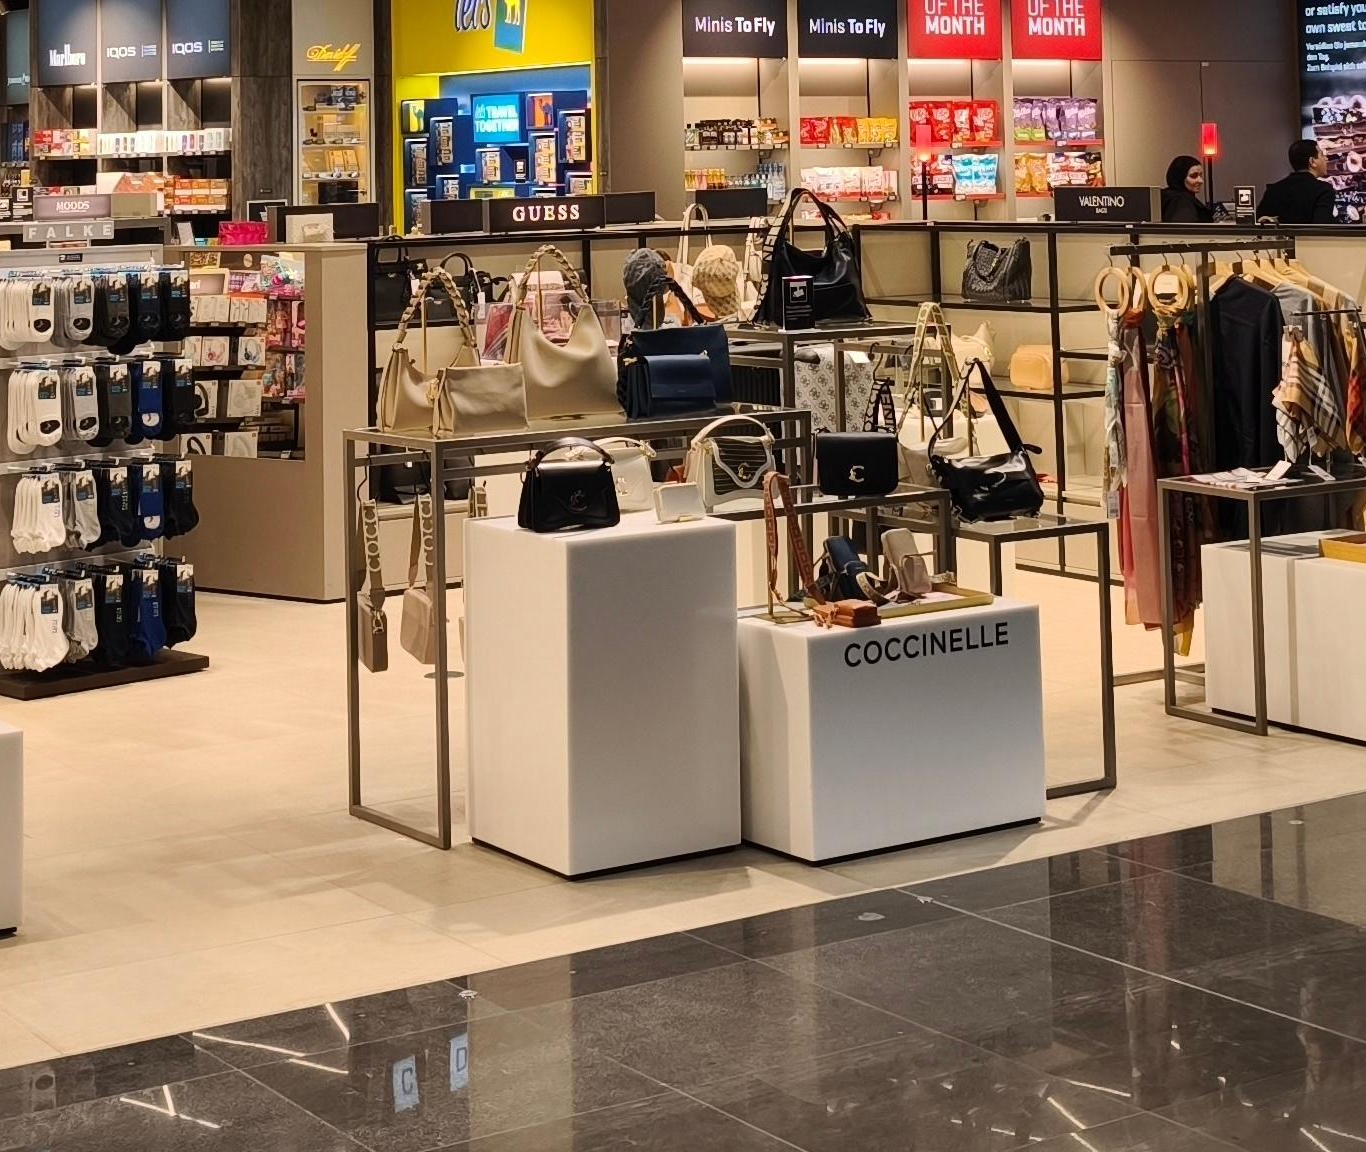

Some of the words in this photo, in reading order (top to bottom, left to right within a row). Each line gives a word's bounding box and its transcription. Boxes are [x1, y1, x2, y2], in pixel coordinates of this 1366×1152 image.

[1305, 6, 1316, 17] or
[1316, 2, 1349, 17] satisfy
[695, 16, 733, 33] Minis
[735, 16, 752, 33] To
[754, 16, 776, 37] Fly
[809, 18, 846, 34] Minis
[847, 18, 864, 34] To
[865, 18, 886, 38] Fly
[925, 15, 985, 35] MONTH
[1028, 17, 1085, 36] MONTH
[1305, 24, 1326, 34] own
[1327, 21, 1356, 33] sweet
[106, 47, 137, 59] IQOS
[172, 42, 203, 55] IQOS
[56, 200, 90, 211] MOODS
[1078, 195, 1124, 208] VALENTINO
[512, 203, 580, 222] GUESS
[28, 223, 112, 239] FALKE
[844, 622, 1009, 667] COCCINELLE
